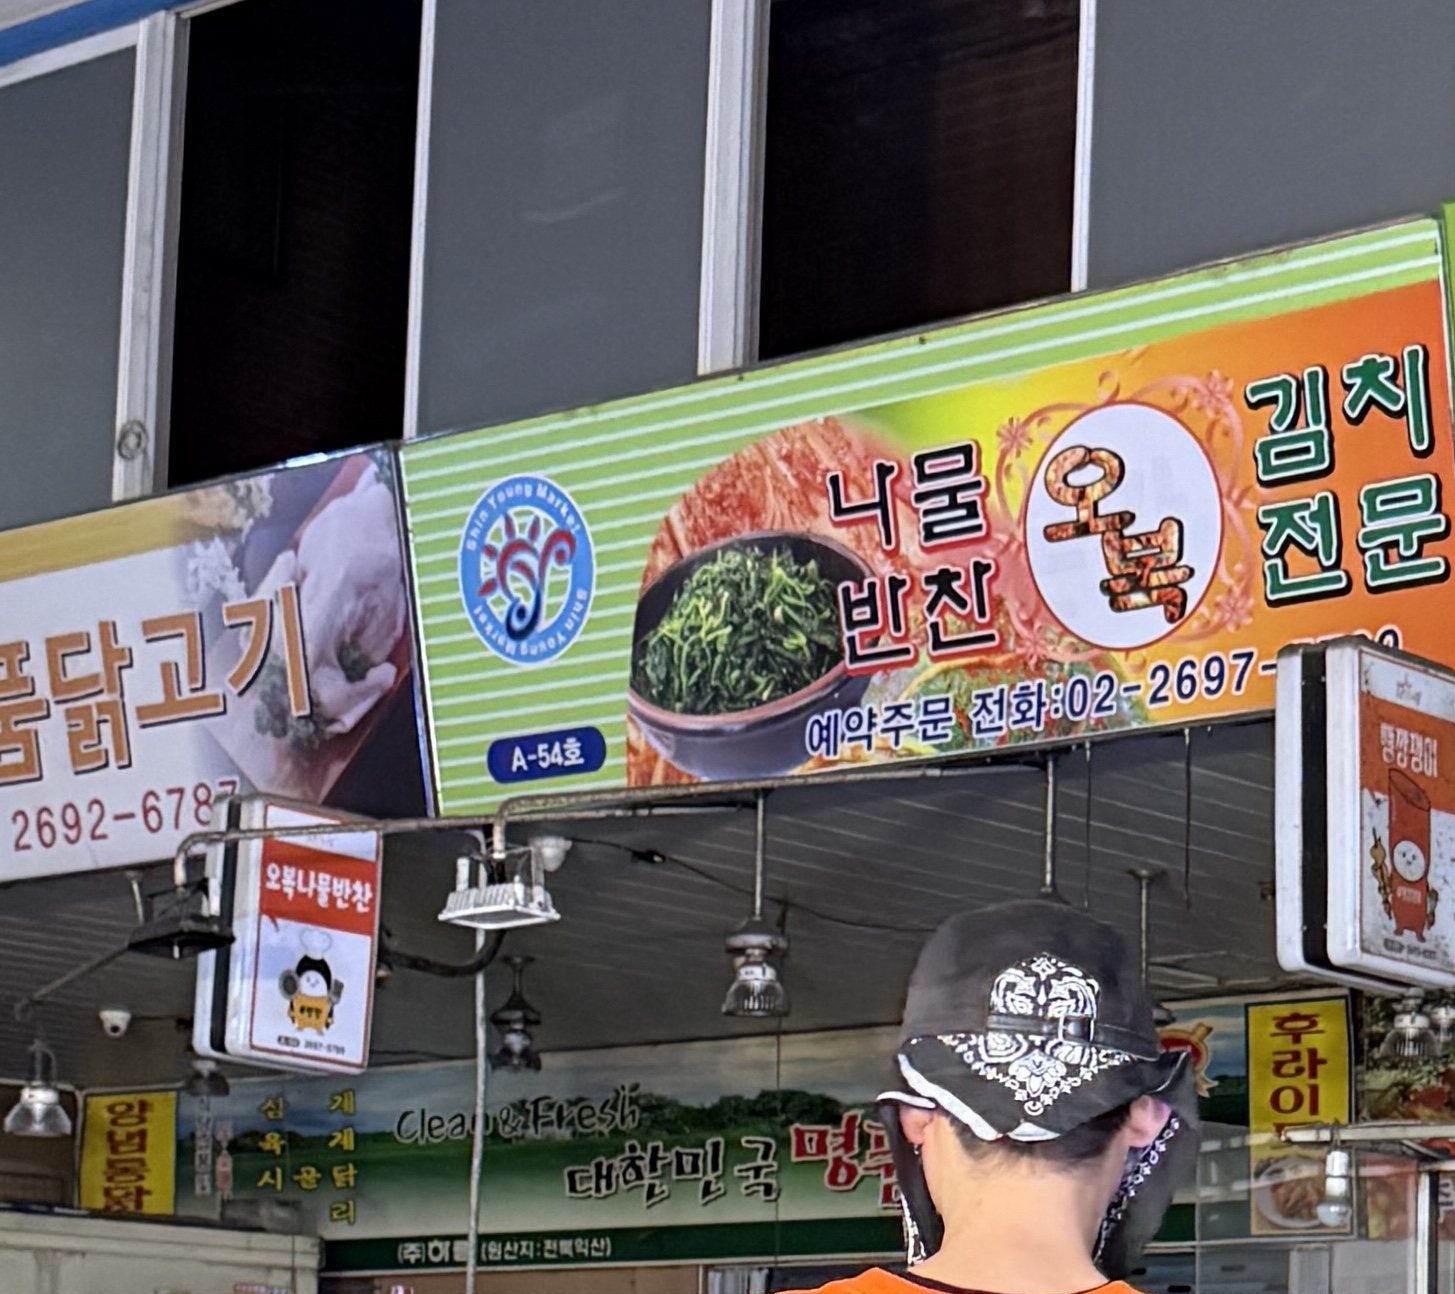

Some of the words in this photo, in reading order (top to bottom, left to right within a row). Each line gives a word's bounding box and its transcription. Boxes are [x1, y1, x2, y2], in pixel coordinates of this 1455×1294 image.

[1247, 345, 1434, 483] 김치
[828, 440, 990, 552] 나물
[1043, 445, 1196, 624] 오복
[1257, 474, 1450, 605] 전문
[840, 561, 1001, 670] 반찬
[511, 735, 586, 774] A-54호
[805, 702, 956, 759] 예약주문
[265, 862, 374, 914] 오복나물반찬
[1269, 1011, 1328, 1138] 후라이
[564, 1137, 779, 1210] 대한민국
